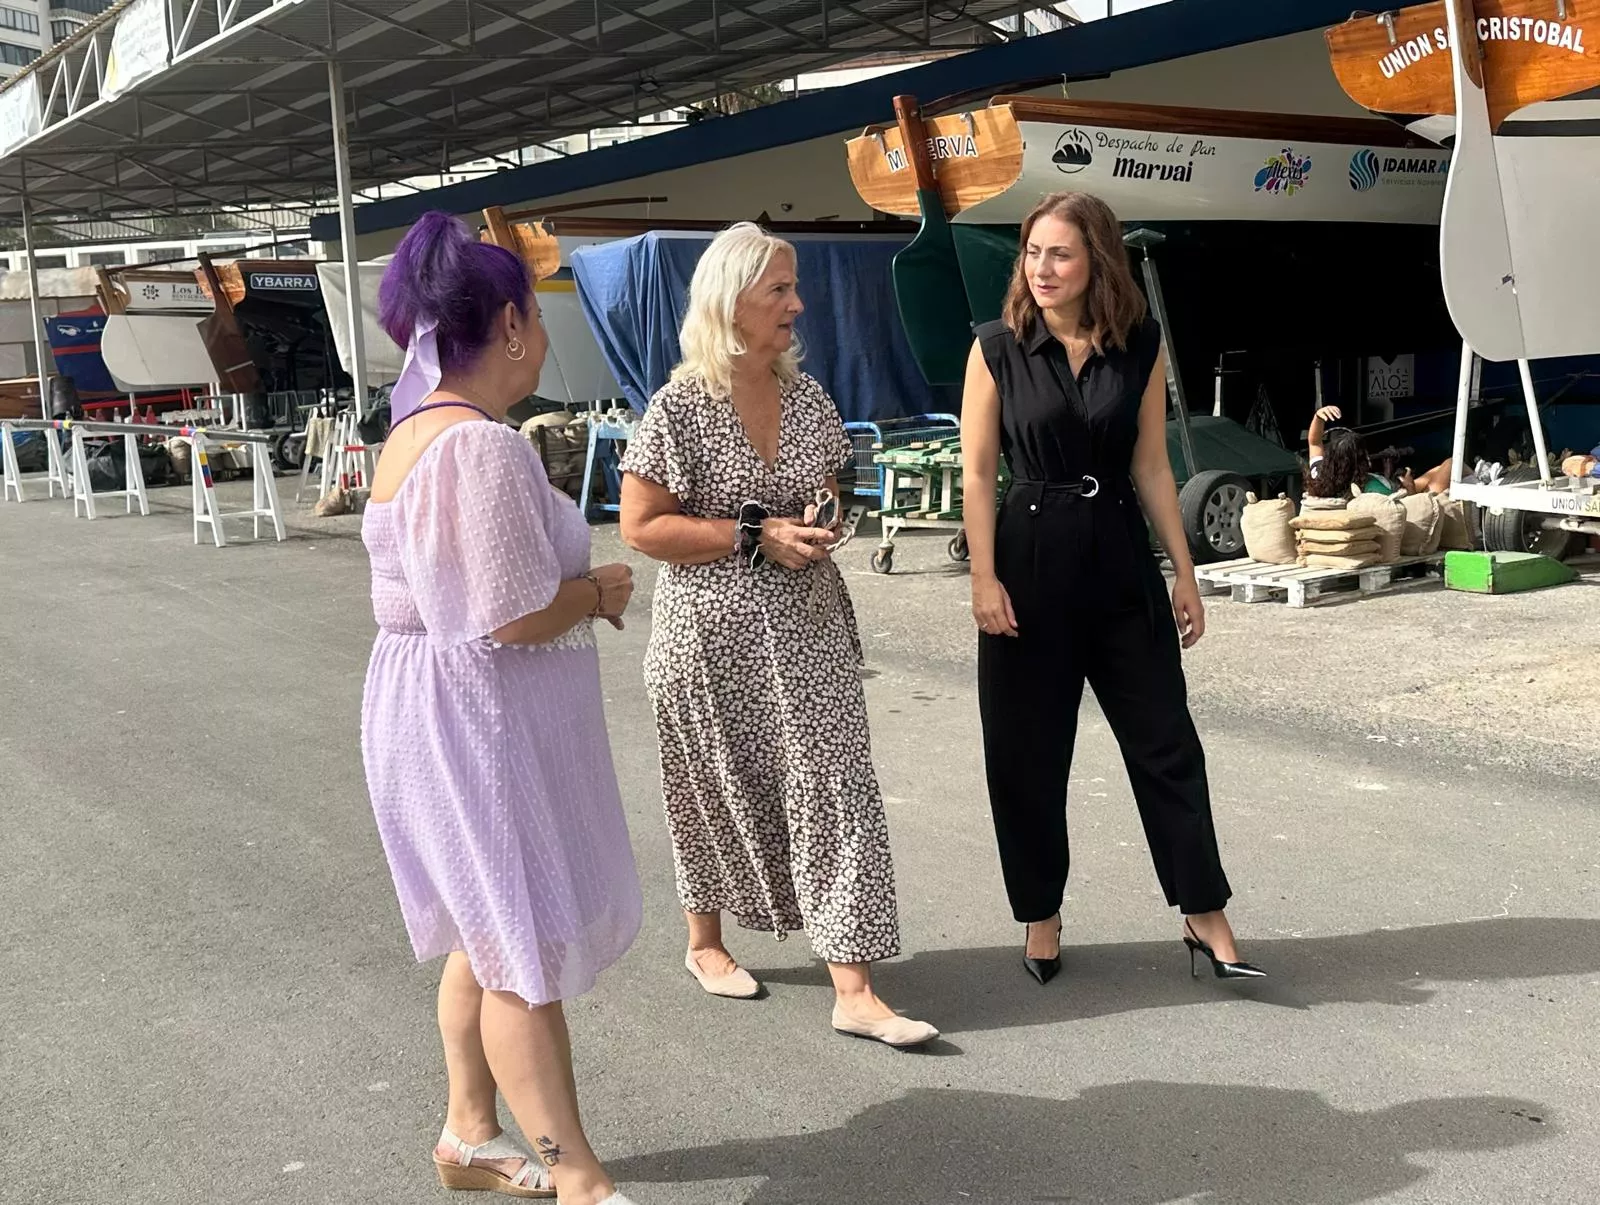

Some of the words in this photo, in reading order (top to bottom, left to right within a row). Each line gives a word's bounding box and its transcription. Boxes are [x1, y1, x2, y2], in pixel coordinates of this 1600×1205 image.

[1378, 33, 1434, 79] UNION
[1476, 17, 1585, 54] CRISTOBAL
[1095, 131, 1159, 155] Despacho
[1166, 136, 1184, 153] de
[1190, 140, 1216, 156] Pan
[1383, 158, 1437, 173] IDAMAR
[171, 284, 192, 294] Los
[255, 276, 313, 288] YBARRA
[1551, 497, 1582, 511] UNION
[1584, 499, 1600, 513] SA
